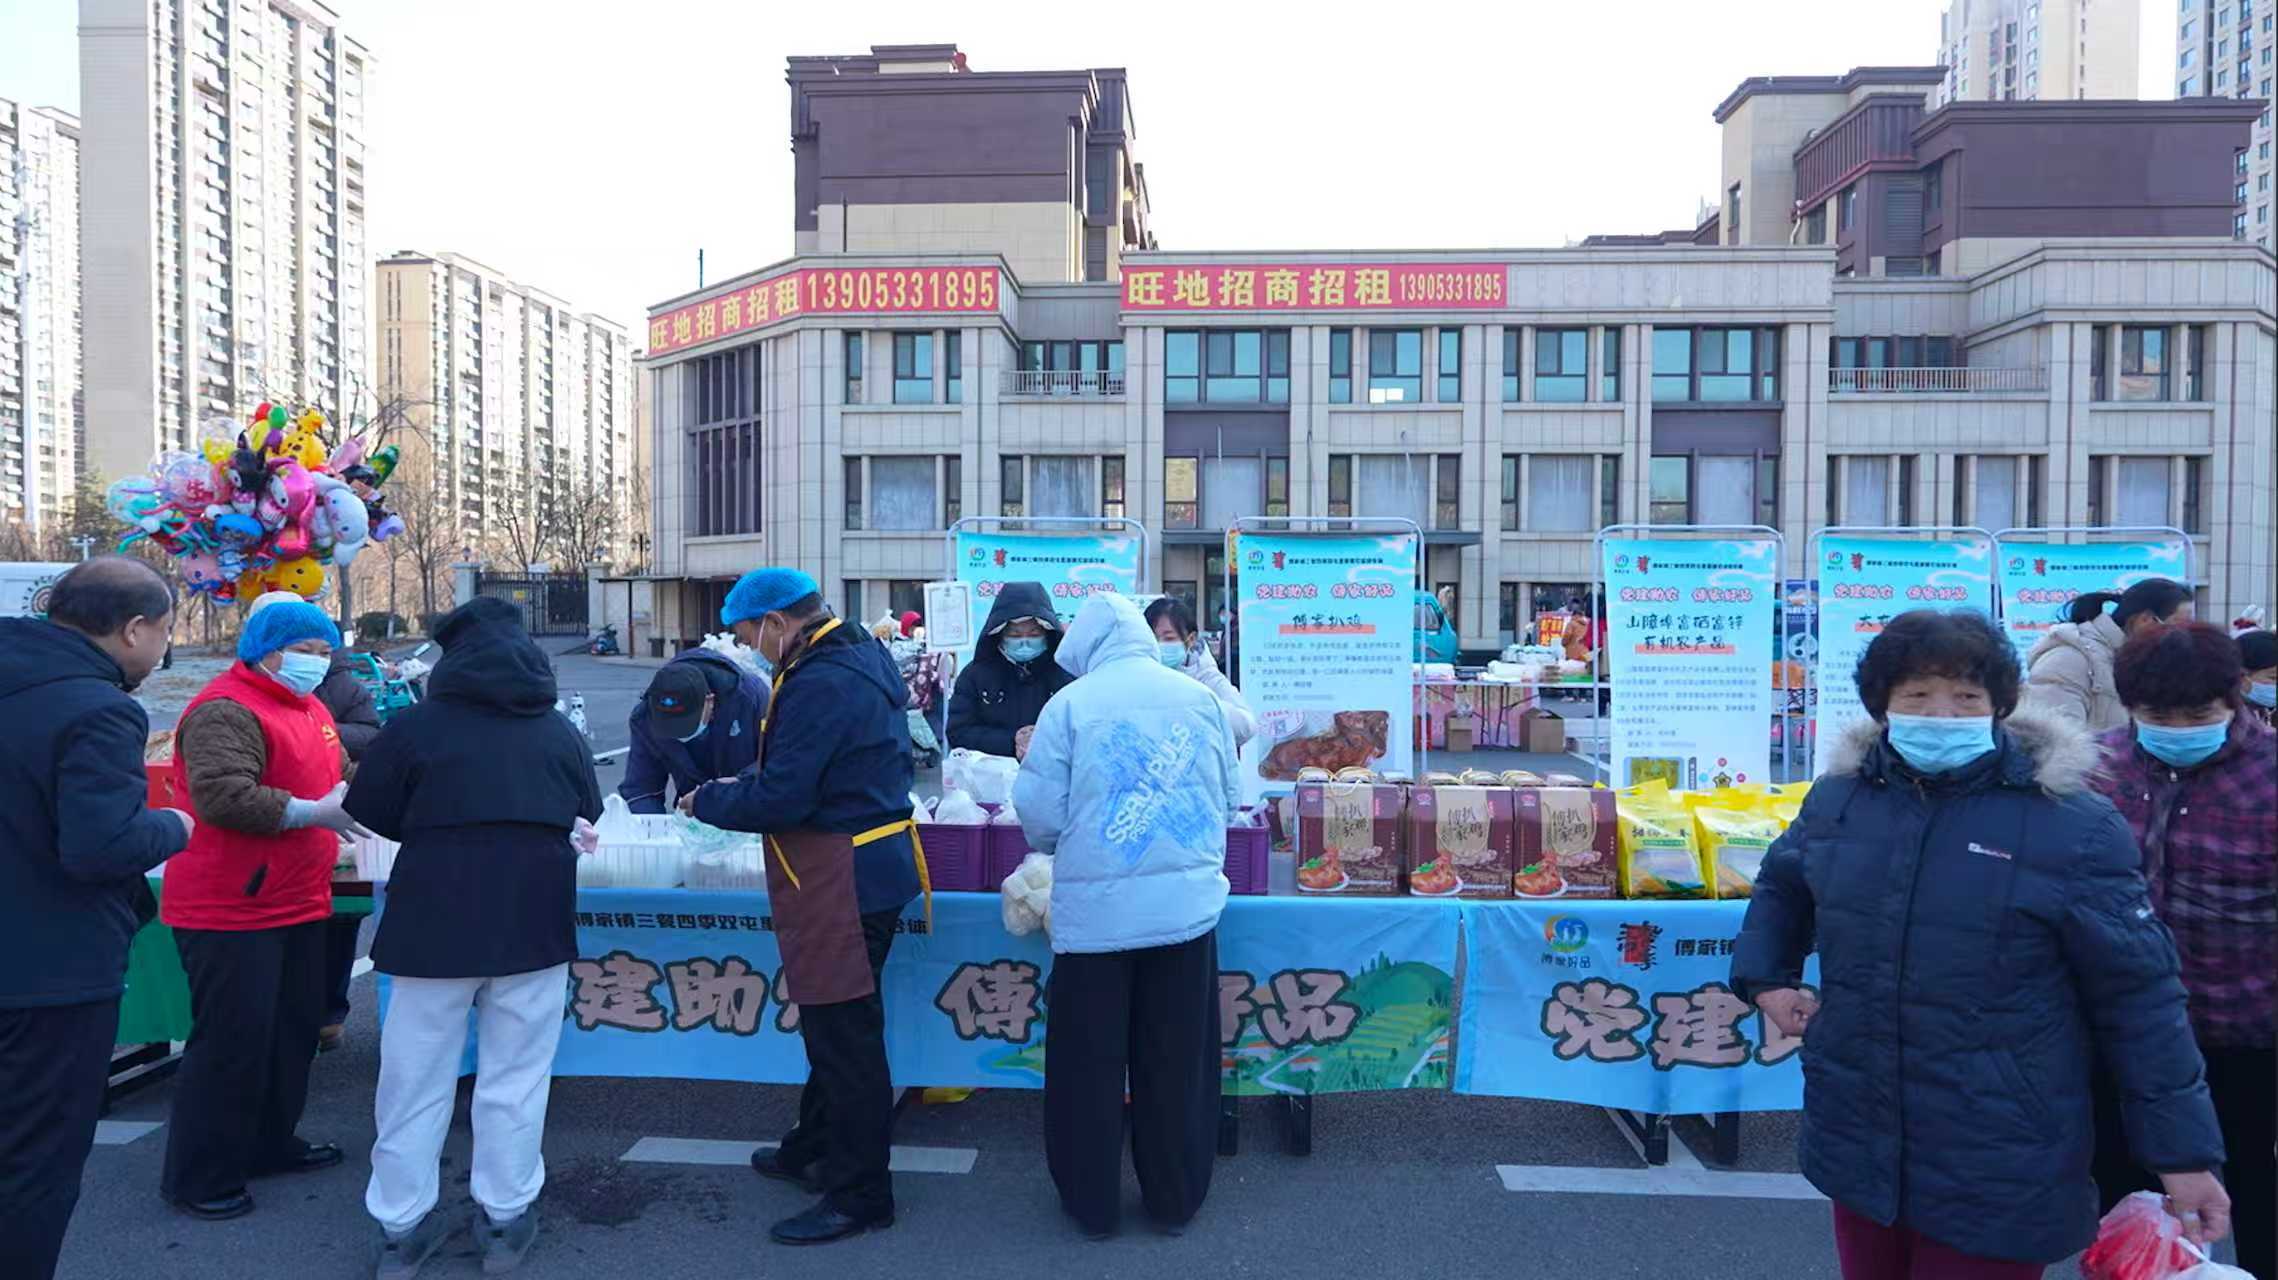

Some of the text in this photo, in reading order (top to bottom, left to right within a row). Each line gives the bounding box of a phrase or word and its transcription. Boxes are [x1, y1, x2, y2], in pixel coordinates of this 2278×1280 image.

[1128, 268, 1501, 306] 旺地招商招租 13905331895
[649, 271, 994, 350] 旺地招商招租 13905331895
[1644, 635, 1726, 651] 有机农产品
